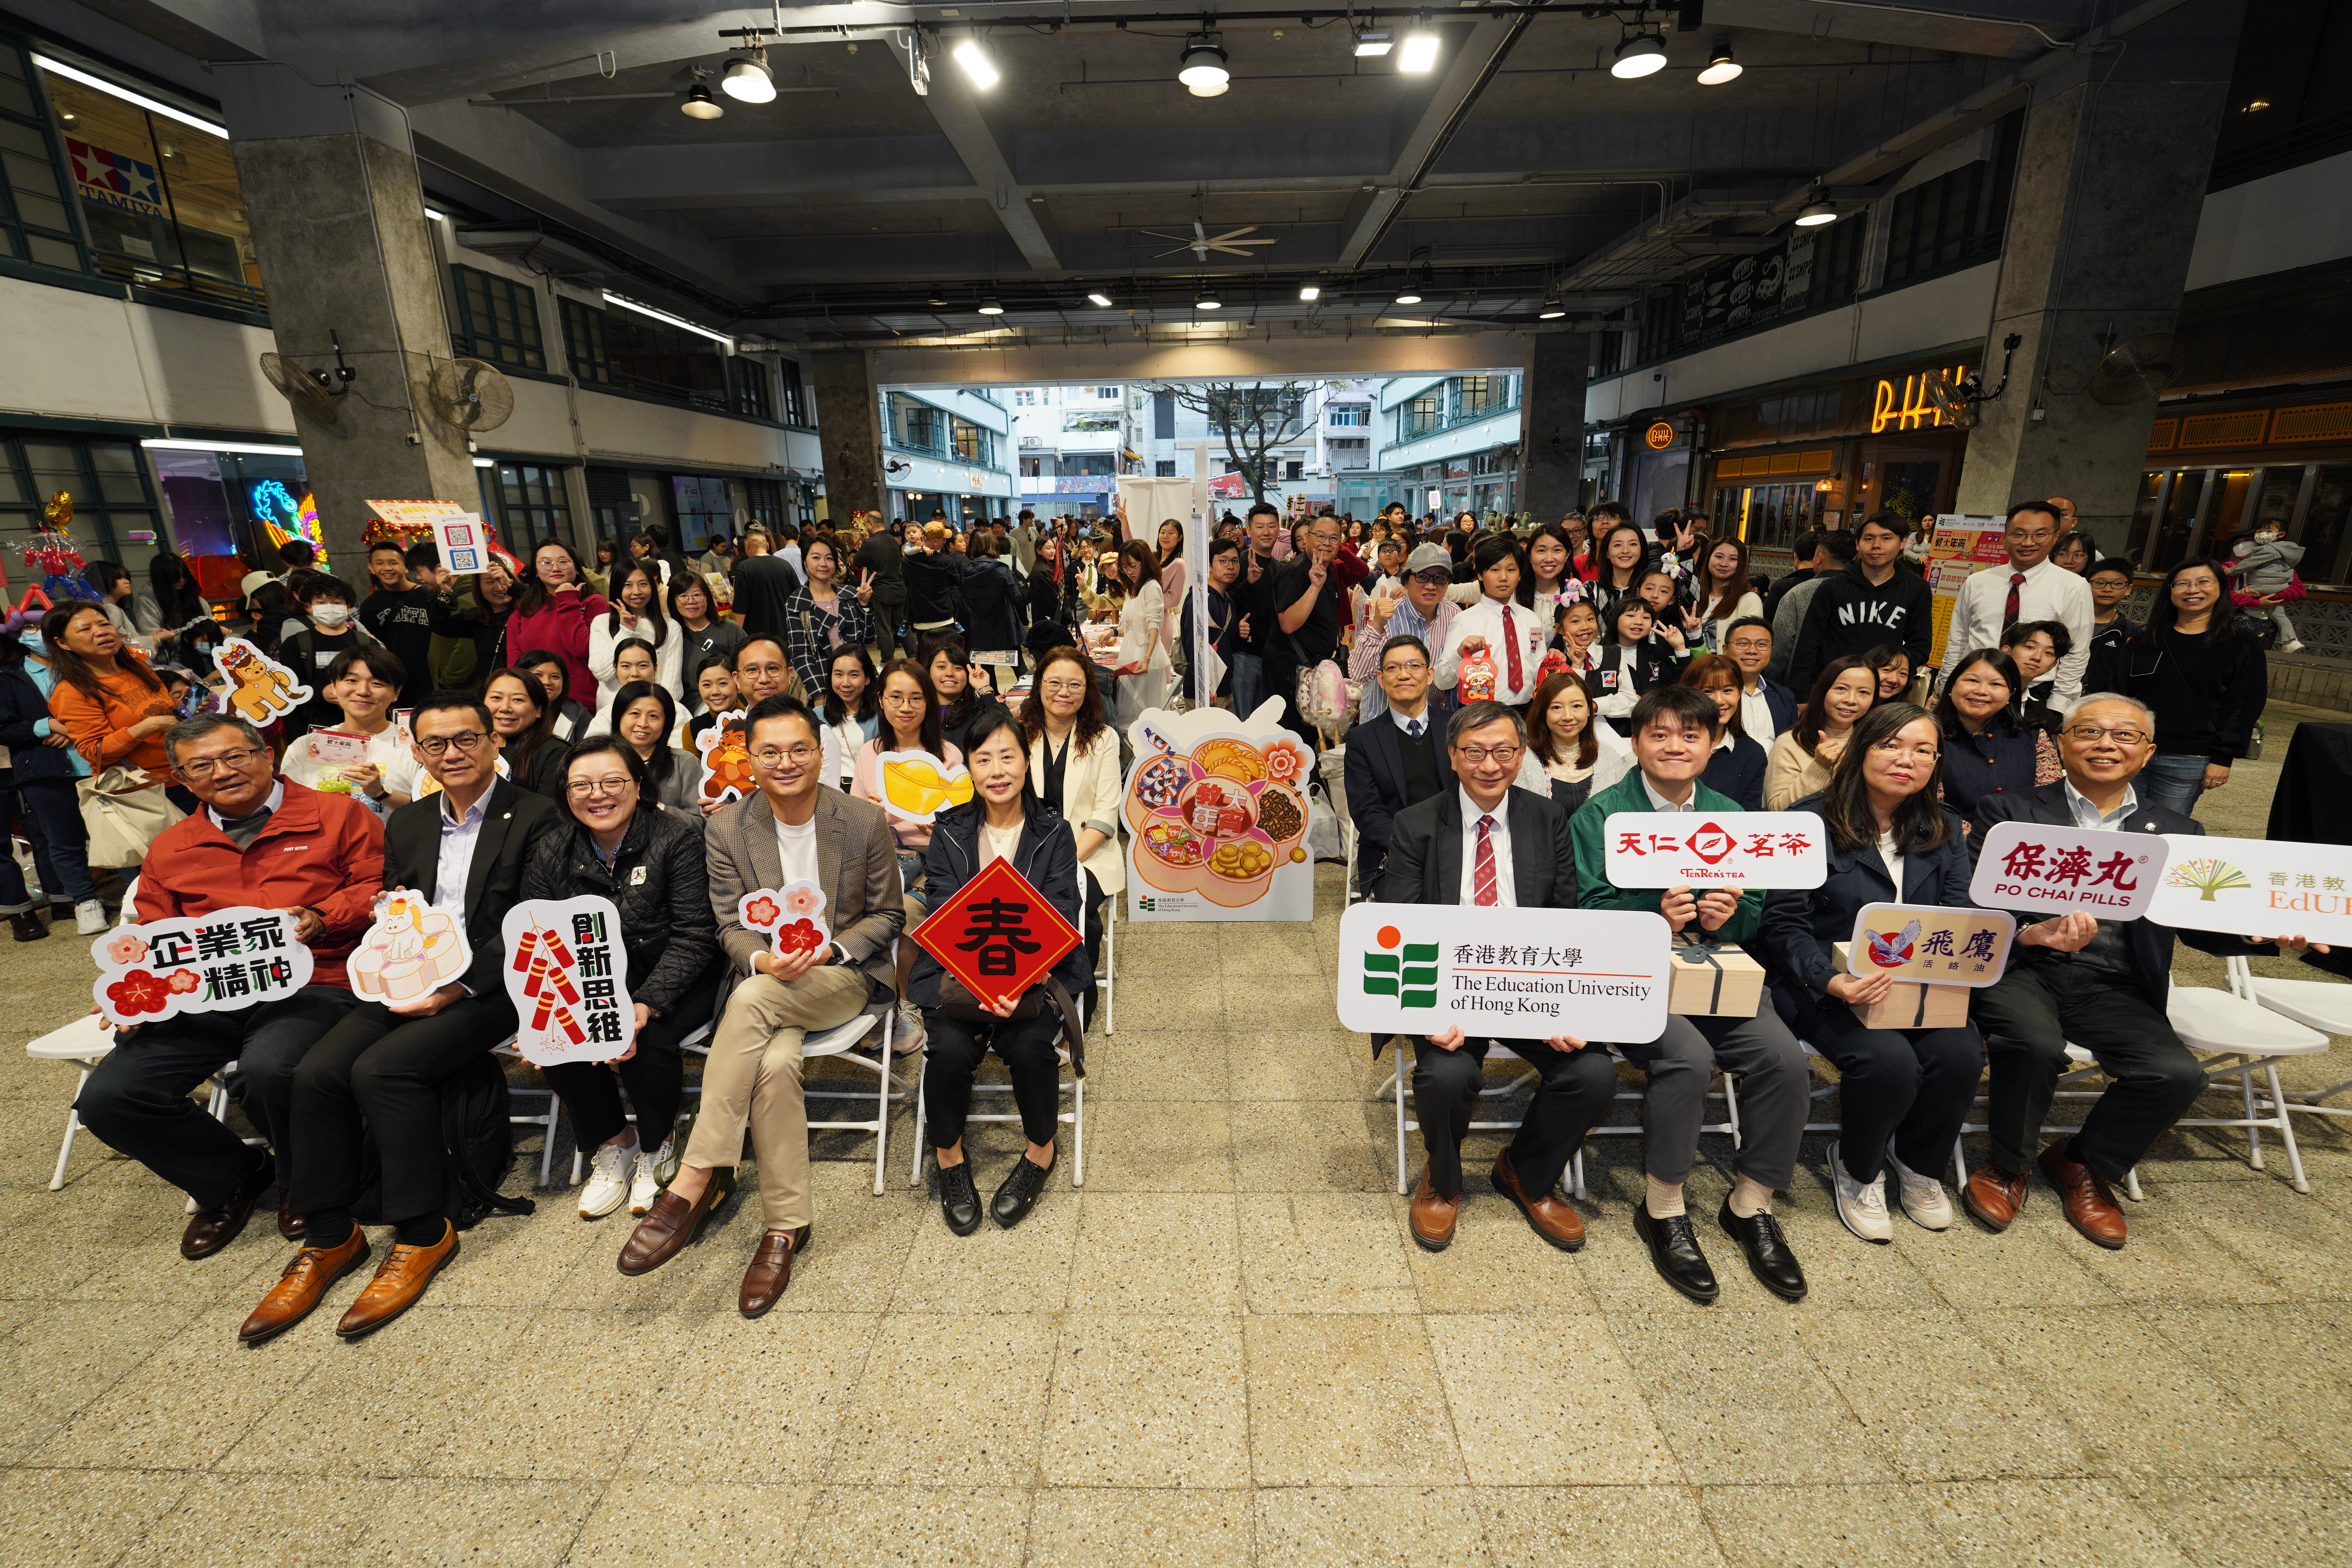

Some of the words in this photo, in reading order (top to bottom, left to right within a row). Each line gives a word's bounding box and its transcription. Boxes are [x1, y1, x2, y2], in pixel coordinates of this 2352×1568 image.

[79, 184, 167, 222] TAMIYA
[1935, 537, 1966, 549] 教大年宵
[1838, 600, 1906, 629] NIKE
[1616, 833, 1680, 856] 天仁
[1743, 833, 1811, 858] 茗茶
[2001, 842, 2137, 891] 保濟丸
[1994, 883, 2021, 896] PO
[2026, 887, 2075, 901] CHAI
[2078, 892, 2132, 907] PILLS
[2268, 872, 2346, 892] 香港教
[2267, 890, 2352, 915] EdU
[148, 916, 286, 970] 企業家
[955, 897, 1042, 976] 春
[1921, 929, 1997, 963] 飛鷹
[1453, 944, 1582, 968] 香港教育大學
[1922, 959, 1985, 972] 活絡油
[201, 956, 293, 1003] 精神
[571, 911, 623, 1044] 創新思維
[1452, 975, 1482, 991] The
[1485, 976, 1564, 994] Education
[1568, 979, 1651, 1001] University
[1451, 995, 1471, 1010] of
[1470, 996, 1514, 1015] Hong
[1517, 997, 1560, 1017] Kong
